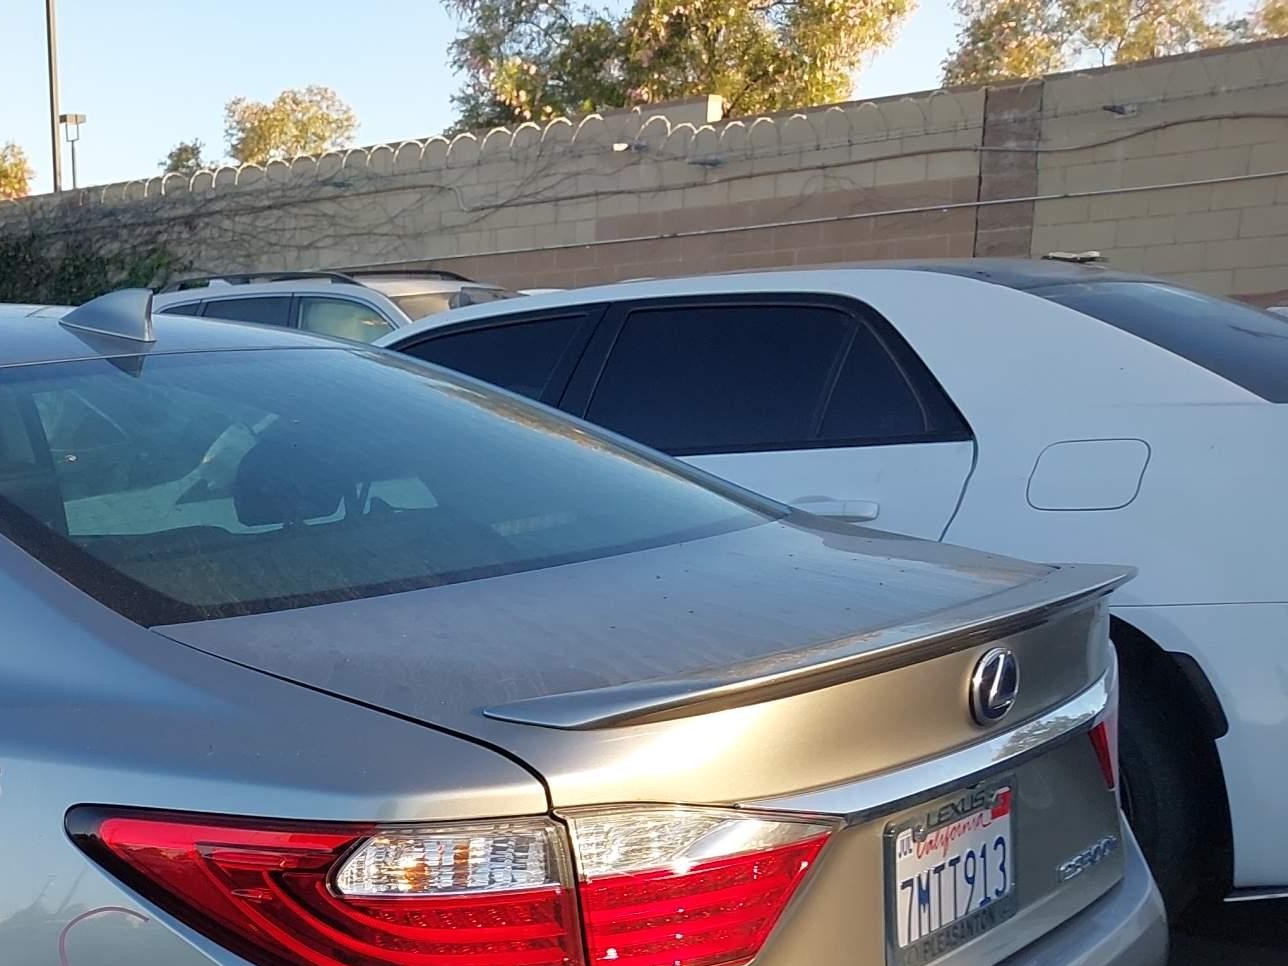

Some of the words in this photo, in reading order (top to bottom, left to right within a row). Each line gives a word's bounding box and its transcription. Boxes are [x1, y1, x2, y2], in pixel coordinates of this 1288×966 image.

[927, 791, 985, 828] LEXUS
[916, 812, 992, 859] California
[900, 836, 1007, 945] 7MTT913
